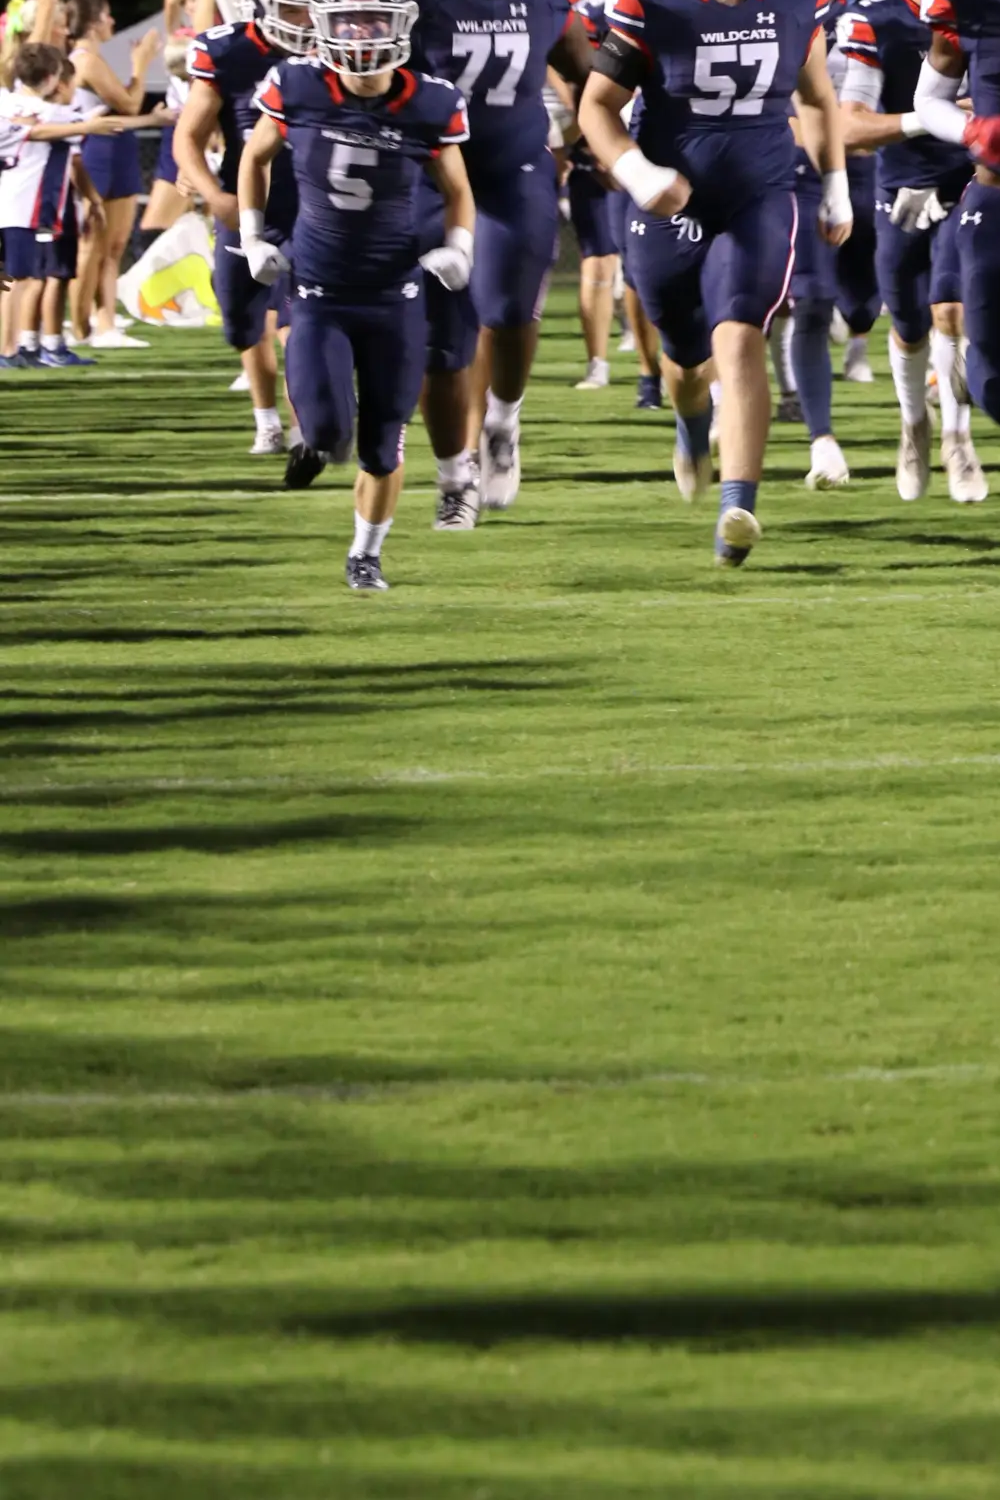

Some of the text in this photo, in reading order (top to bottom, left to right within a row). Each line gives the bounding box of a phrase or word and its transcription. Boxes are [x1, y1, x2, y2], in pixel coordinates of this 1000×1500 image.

[456, 20, 527, 32] WILDCATS
[701, 29, 777, 43] WILDCATS
[452, 32, 530, 106] 77
[688, 42, 780, 116] 57
[327, 143, 379, 211] 5
